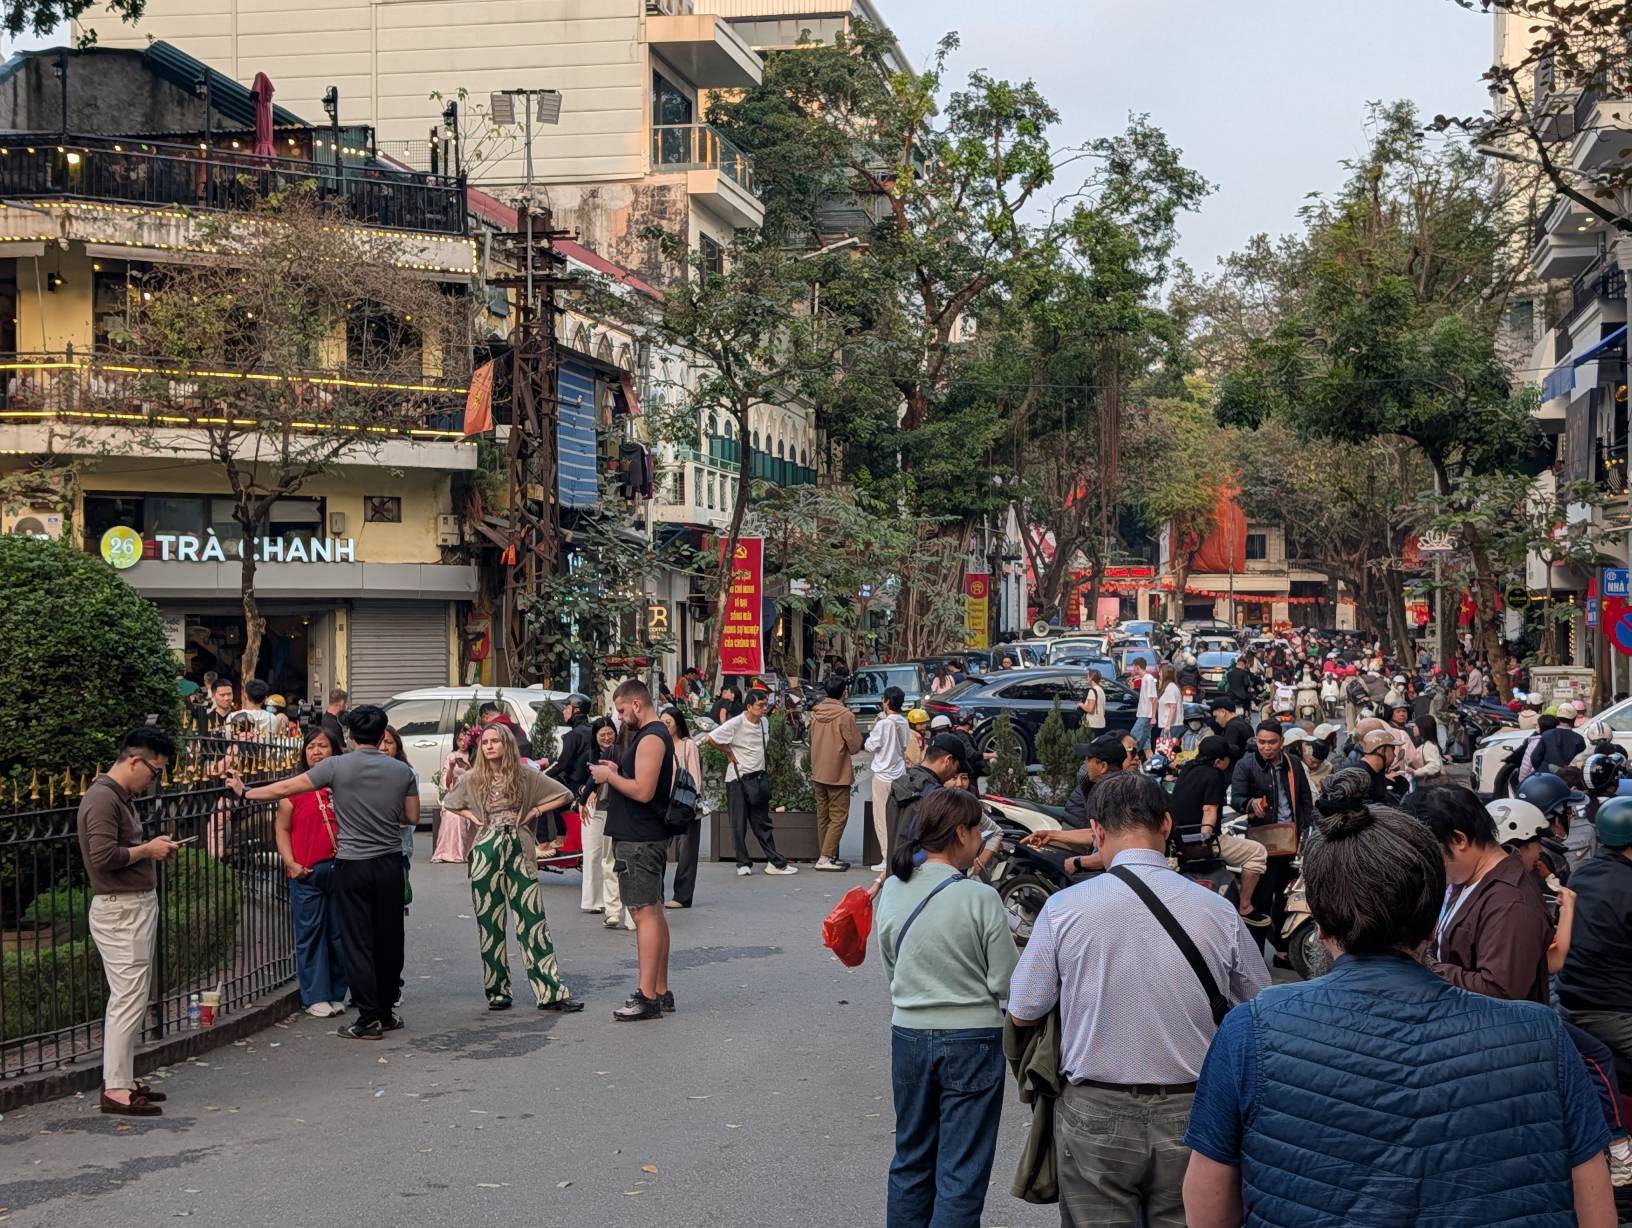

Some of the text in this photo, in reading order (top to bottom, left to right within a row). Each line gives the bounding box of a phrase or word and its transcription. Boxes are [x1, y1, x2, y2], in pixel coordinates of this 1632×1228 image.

[110, 537, 135, 554] 26
[155, 528, 355, 563] TRÀ CHANH
